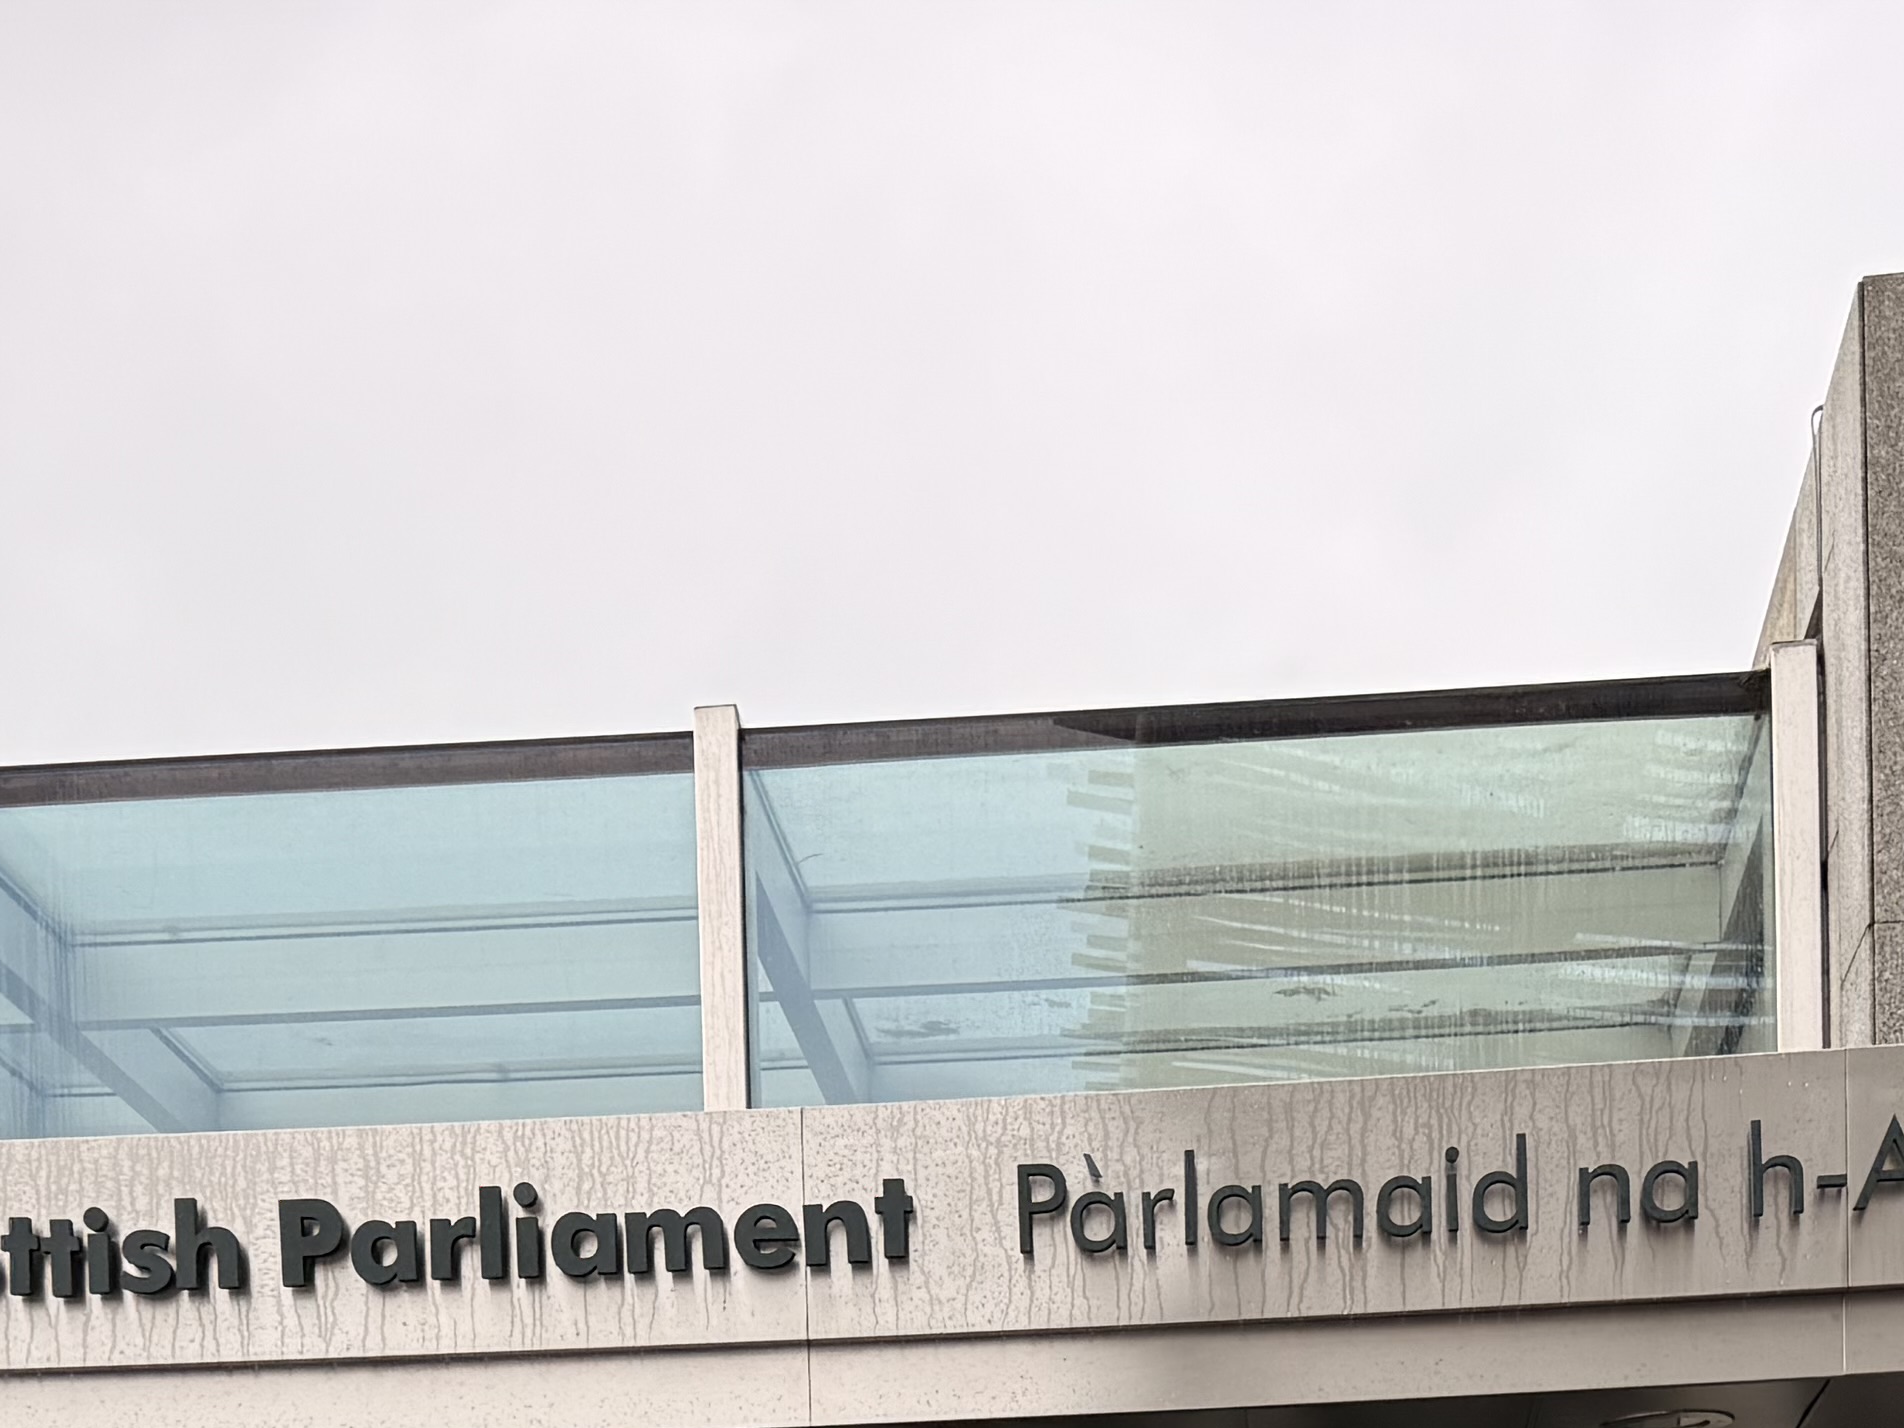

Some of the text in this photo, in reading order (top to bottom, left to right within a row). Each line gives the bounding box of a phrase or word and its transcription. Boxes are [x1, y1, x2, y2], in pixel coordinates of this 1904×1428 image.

[279, 1179, 914, 1292] Parliament
[1018, 1134, 1528, 1260] Pàrlamaid
[1579, 1161, 1698, 1235] na
